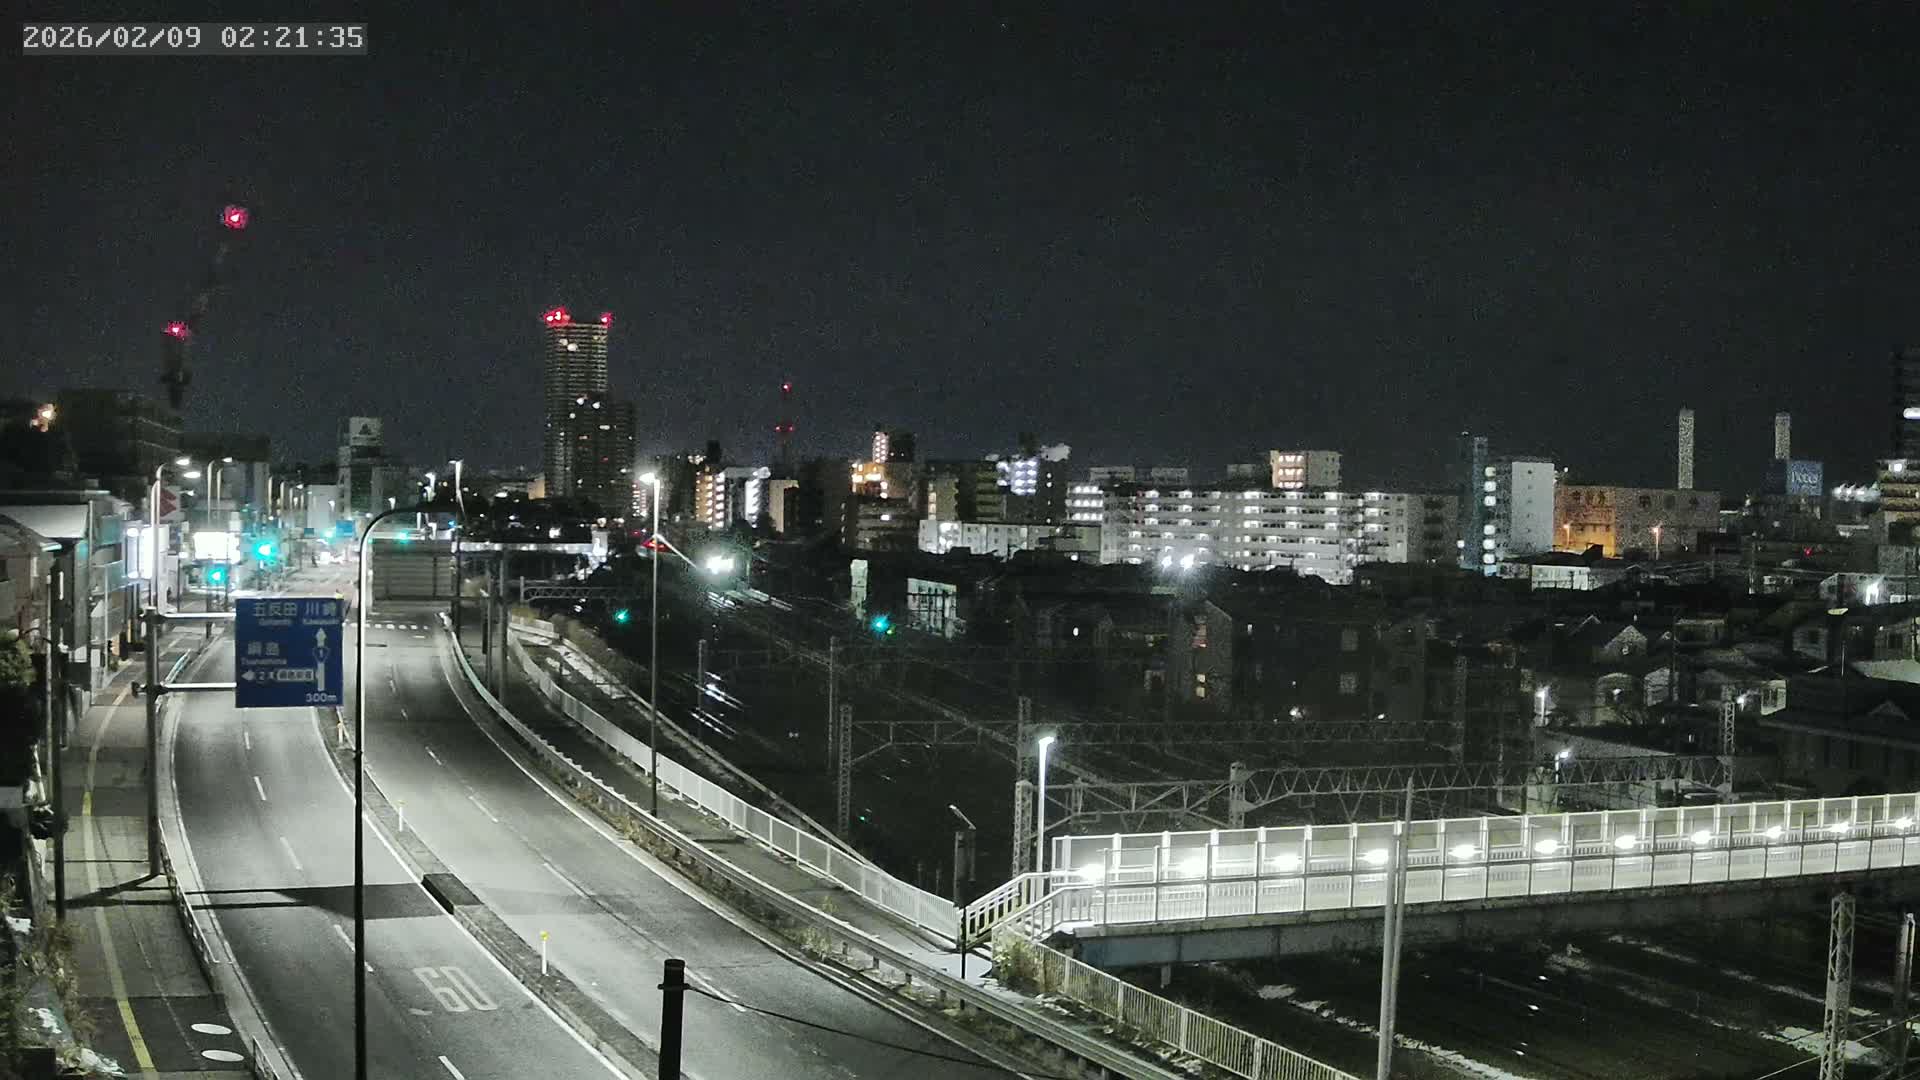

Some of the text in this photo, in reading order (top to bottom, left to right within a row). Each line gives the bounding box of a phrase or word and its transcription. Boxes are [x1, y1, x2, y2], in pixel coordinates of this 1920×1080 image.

[253, 602, 297, 617] 五反田
[305, 692, 337, 703] 300m
[412, 966, 499, 1012] 60
